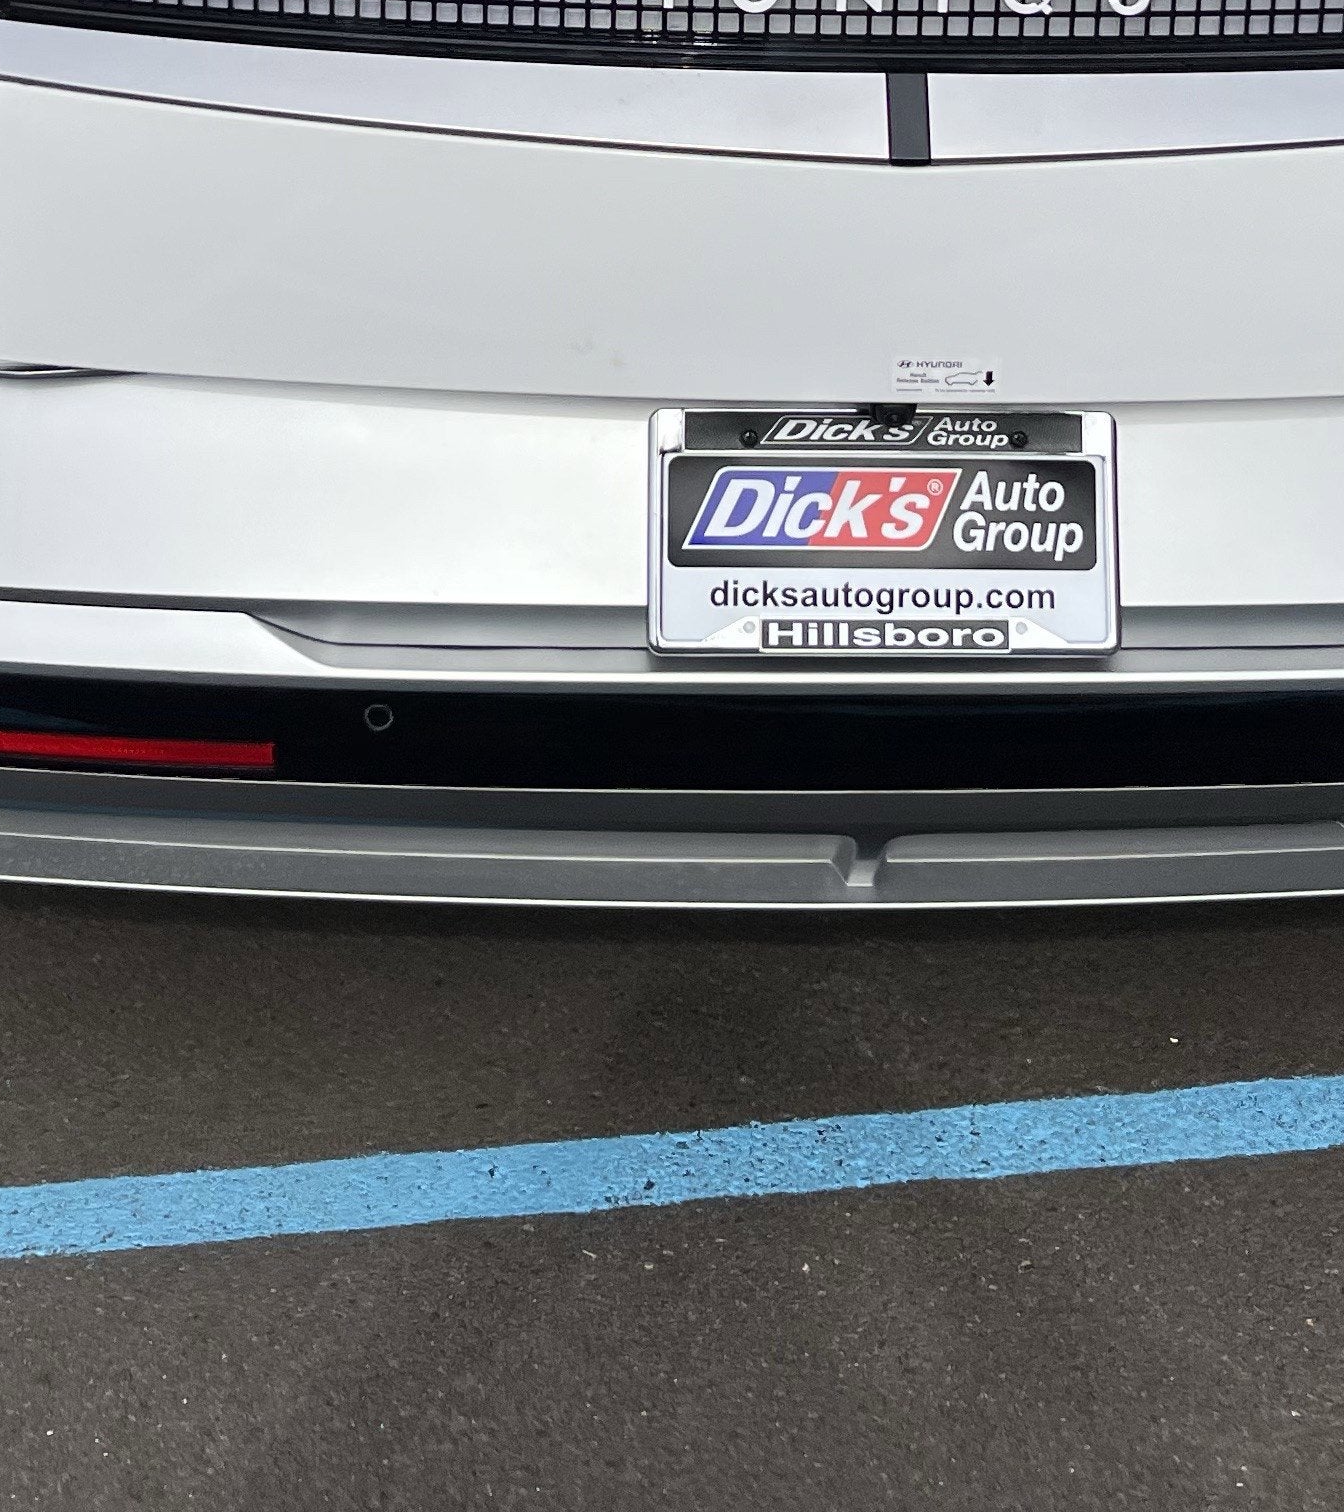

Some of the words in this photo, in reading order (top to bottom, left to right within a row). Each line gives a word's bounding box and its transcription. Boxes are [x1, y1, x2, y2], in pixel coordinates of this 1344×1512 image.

[916, 360, 963, 369] HYUNDAI
[773, 418, 915, 442] Dicks
[933, 416, 998, 432] Auto
[927, 431, 1009, 449] Group
[959, 470, 1065, 512] Auto
[952, 511, 1085, 562] Group
[709, 579, 1056, 615] dicksautogroup.com
[766, 621, 1006, 648] Hillsboro
